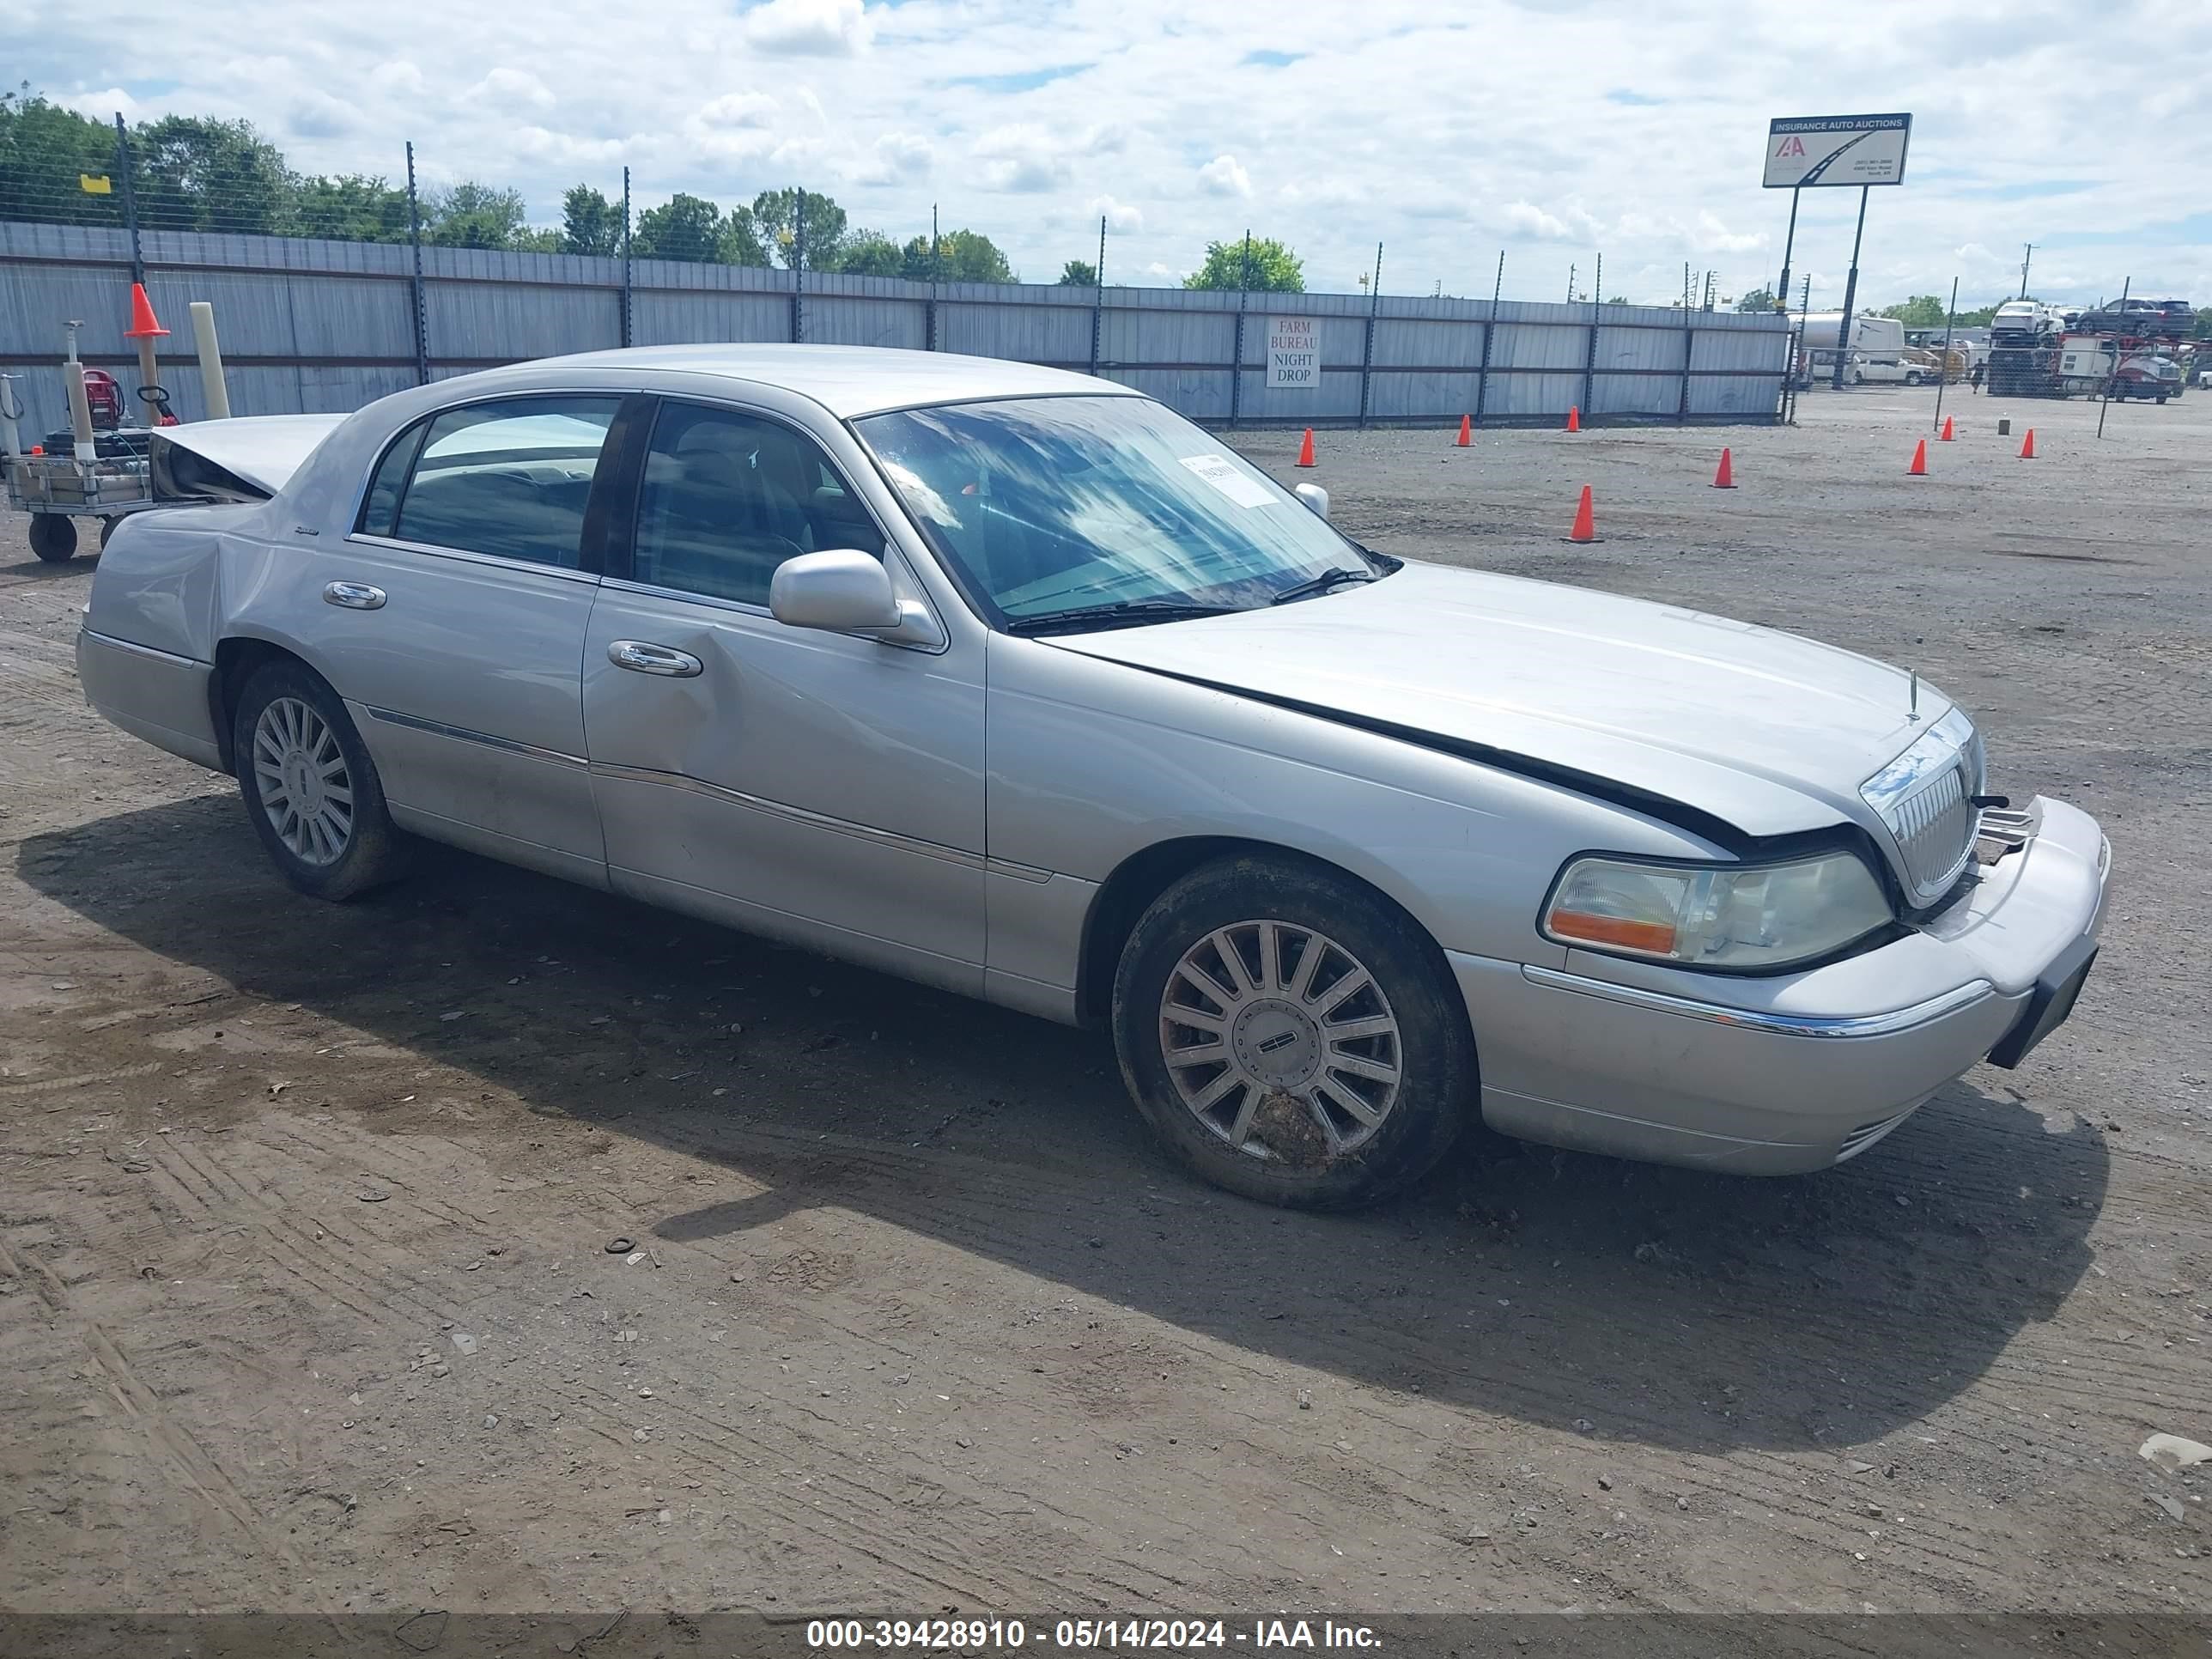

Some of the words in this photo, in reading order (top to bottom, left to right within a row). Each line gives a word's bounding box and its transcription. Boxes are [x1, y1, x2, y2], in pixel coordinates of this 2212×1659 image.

[1775, 122, 1826, 131] INSURANCE
[1828, 121, 1854, 130] AUTO
[1855, 118, 1903, 129] AUCTIONS
[1279, 320, 1311, 334] FARM
[1271, 336, 1318, 349] BUREAU
[1274, 354, 1315, 366] NIGHT
[1277, 369, 1311, 382] DROP
